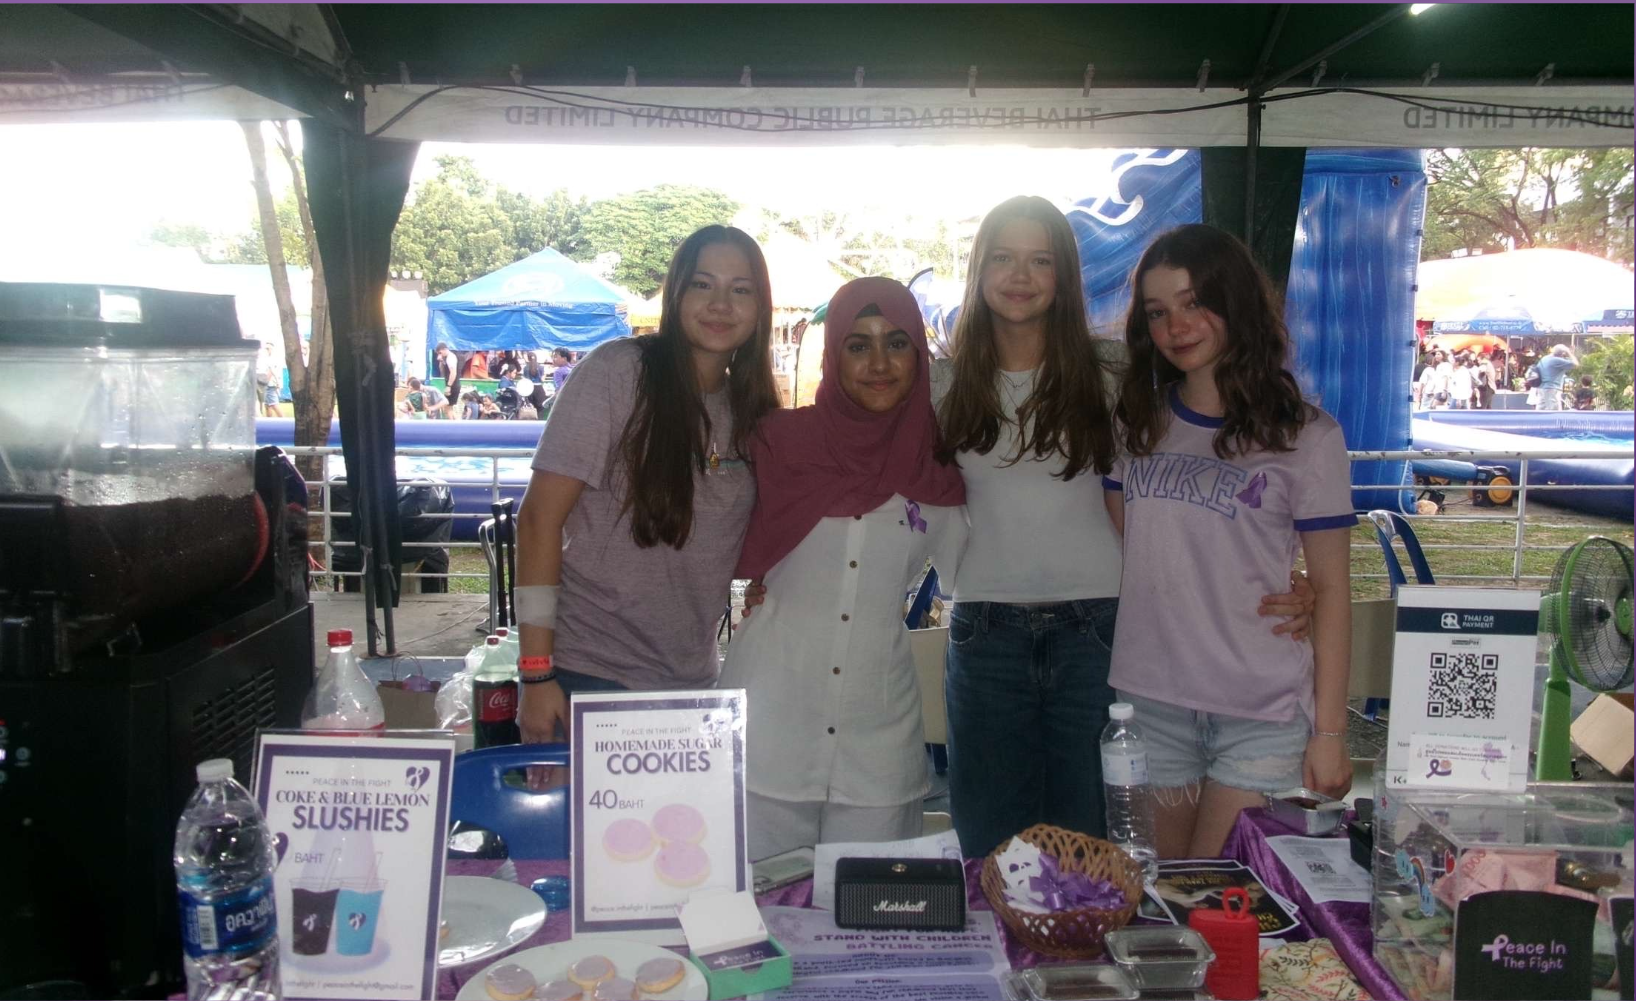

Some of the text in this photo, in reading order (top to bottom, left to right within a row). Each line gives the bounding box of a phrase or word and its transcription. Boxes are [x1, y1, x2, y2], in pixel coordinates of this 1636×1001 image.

[1125, 452, 1248, 520] NIKE
[1462, 621, 1495, 629] PAYMENT
[1463, 614, 1481, 622] THAI
[622, 728, 644, 736] PEACE
[655, 727, 669, 735] THE
[670, 726, 692, 734] FIGHT
[595, 737, 723, 753] HOMEMADE SUGAR
[606, 750, 711, 776] COOKIES
[313, 777, 391, 787] PEACE IN THE FIGHT
[276, 789, 430, 807] COKE & BLUE LEMON
[589, 789, 645, 810] 40 BAHT
[292, 804, 410, 833] SLUSHIES
[294, 852, 324, 864] BAHT
[873, 900, 927, 912] Marshall
[813, 934, 991, 942] STAND WITH CHILDREN
[846, 942, 993, 951] BATTLING CANCER
[1549, 938, 1566, 955] In
[1503, 956, 1564, 973] The Fight
